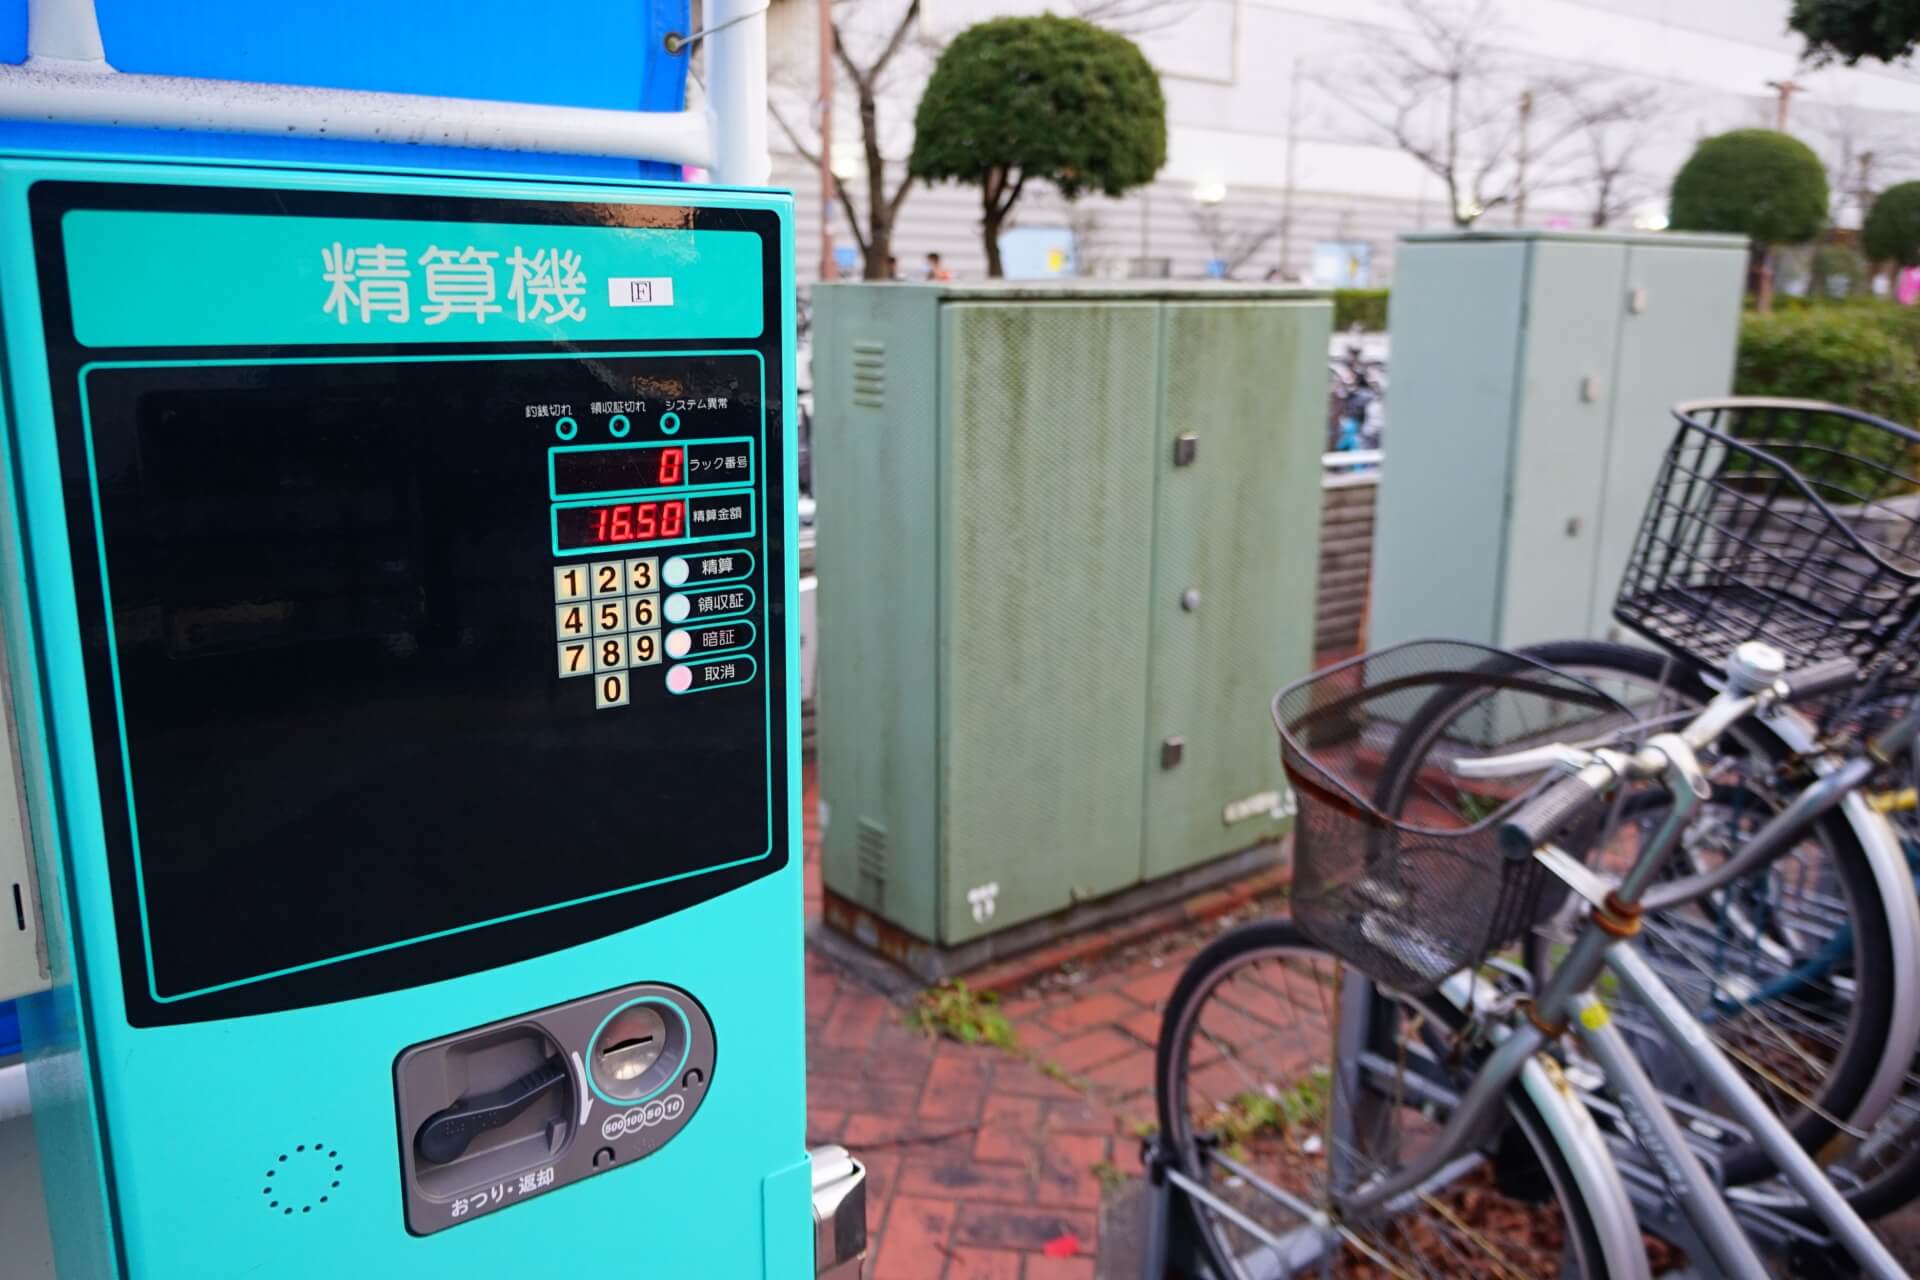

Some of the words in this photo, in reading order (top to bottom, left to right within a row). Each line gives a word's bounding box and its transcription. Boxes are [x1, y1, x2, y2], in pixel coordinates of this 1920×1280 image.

[321, 242, 588, 326] 精算機
[590, 401, 646, 414] 領収証切れ
[665, 398, 728, 411] システム異常
[689, 456, 747, 472] ラック番号
[693, 507, 742, 523] 精算金額
[702, 557, 733, 575] 精算
[564, 570, 577, 596] 1
[599, 566, 617, 593] 2
[633, 563, 651, 588] 3
[698, 593, 744, 612] 領収証
[564, 607, 583, 634] 4
[601, 603, 618, 630] 5
[635, 599, 653, 625] 6
[702, 629, 735, 647] 暗証
[565, 645, 584, 672] 7
[602, 640, 620, 667] 8
[637, 636, 654, 661] 9
[704, 664, 735, 681] 取消
[603, 676, 621, 702] 0
[605, 1119, 624, 1134] 500
[626, 1113, 643, 1127] 100
[647, 1106, 661, 1120] 50
[667, 1100, 680, 1113] 10
